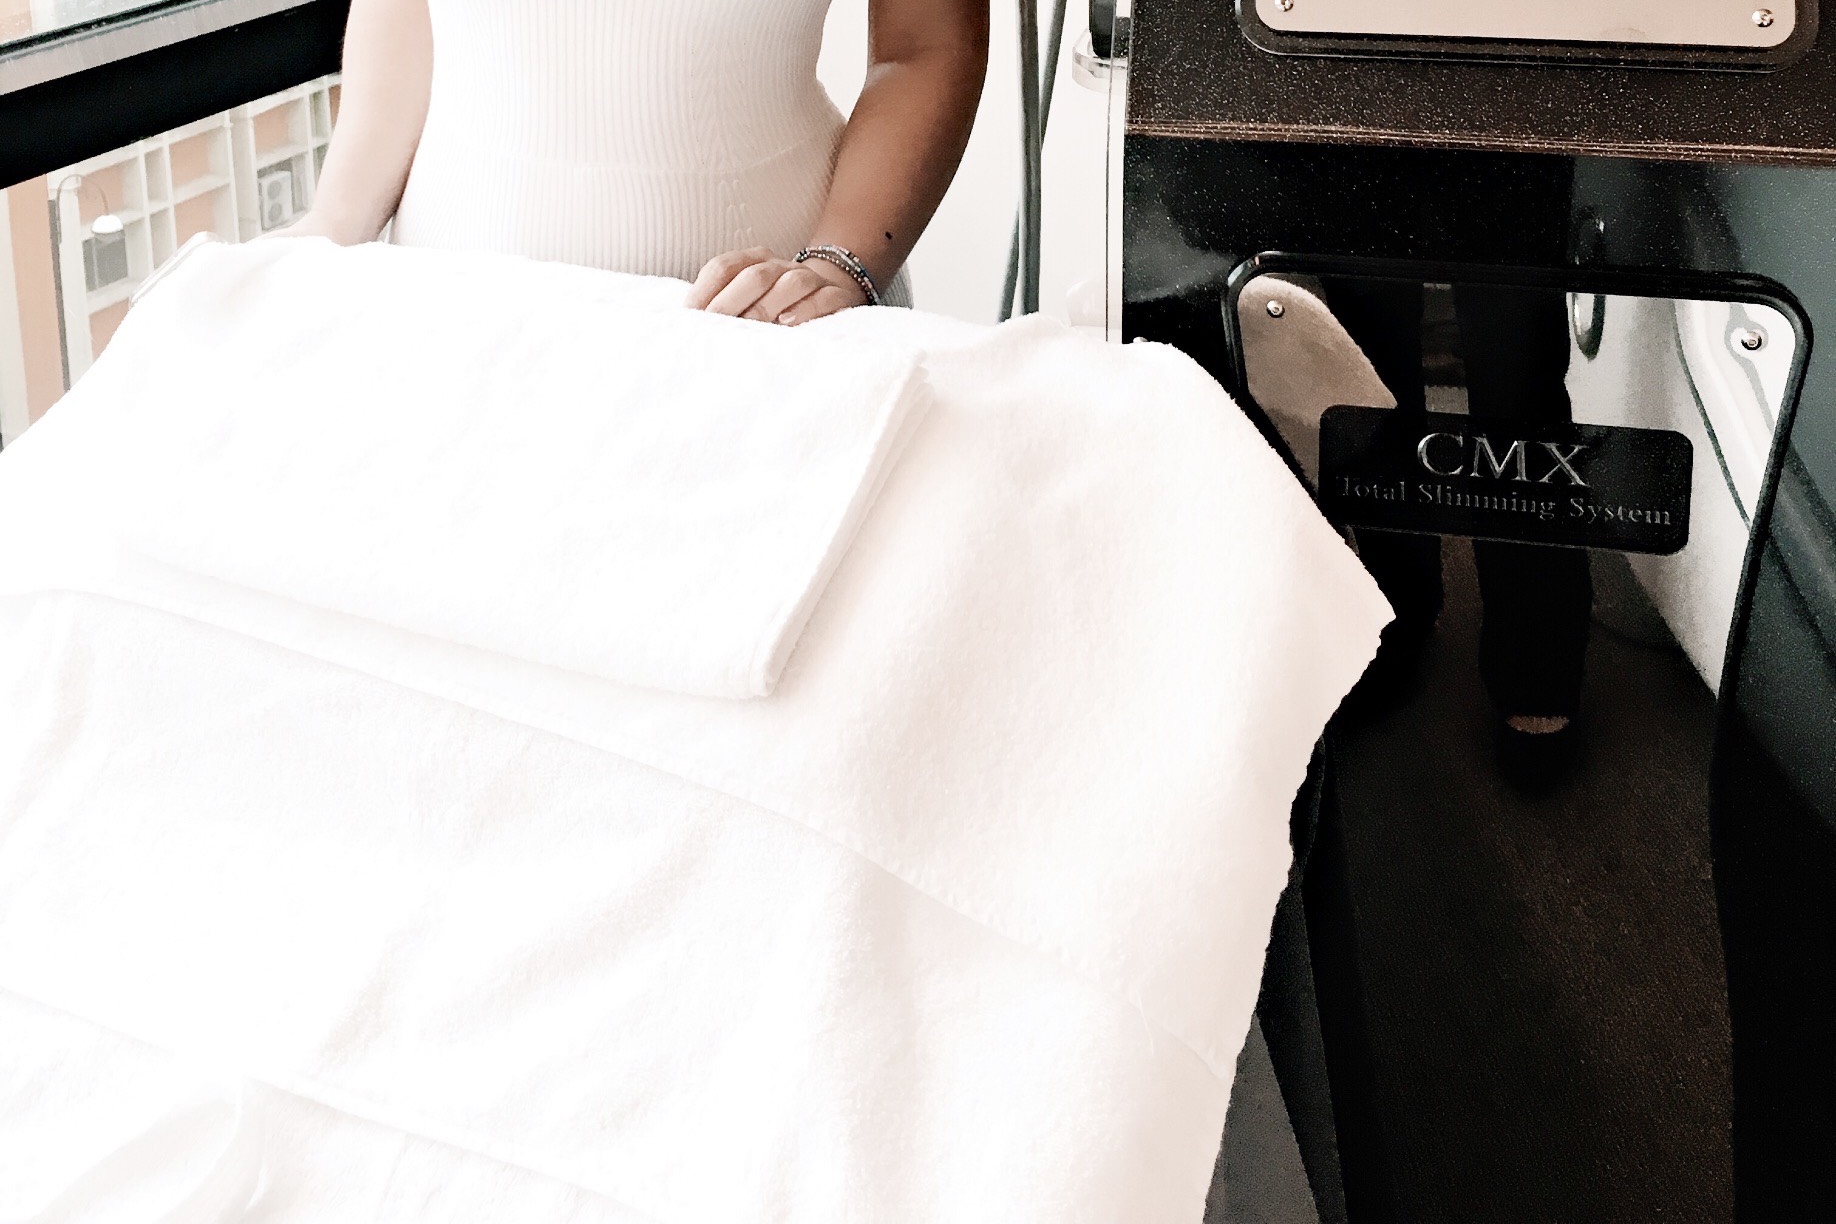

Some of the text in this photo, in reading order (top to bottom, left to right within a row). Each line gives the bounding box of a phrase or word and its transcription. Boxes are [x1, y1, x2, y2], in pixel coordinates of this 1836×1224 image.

[1417, 432, 1589, 487] CMX
[1336, 476, 1671, 525] Total Slimming System
